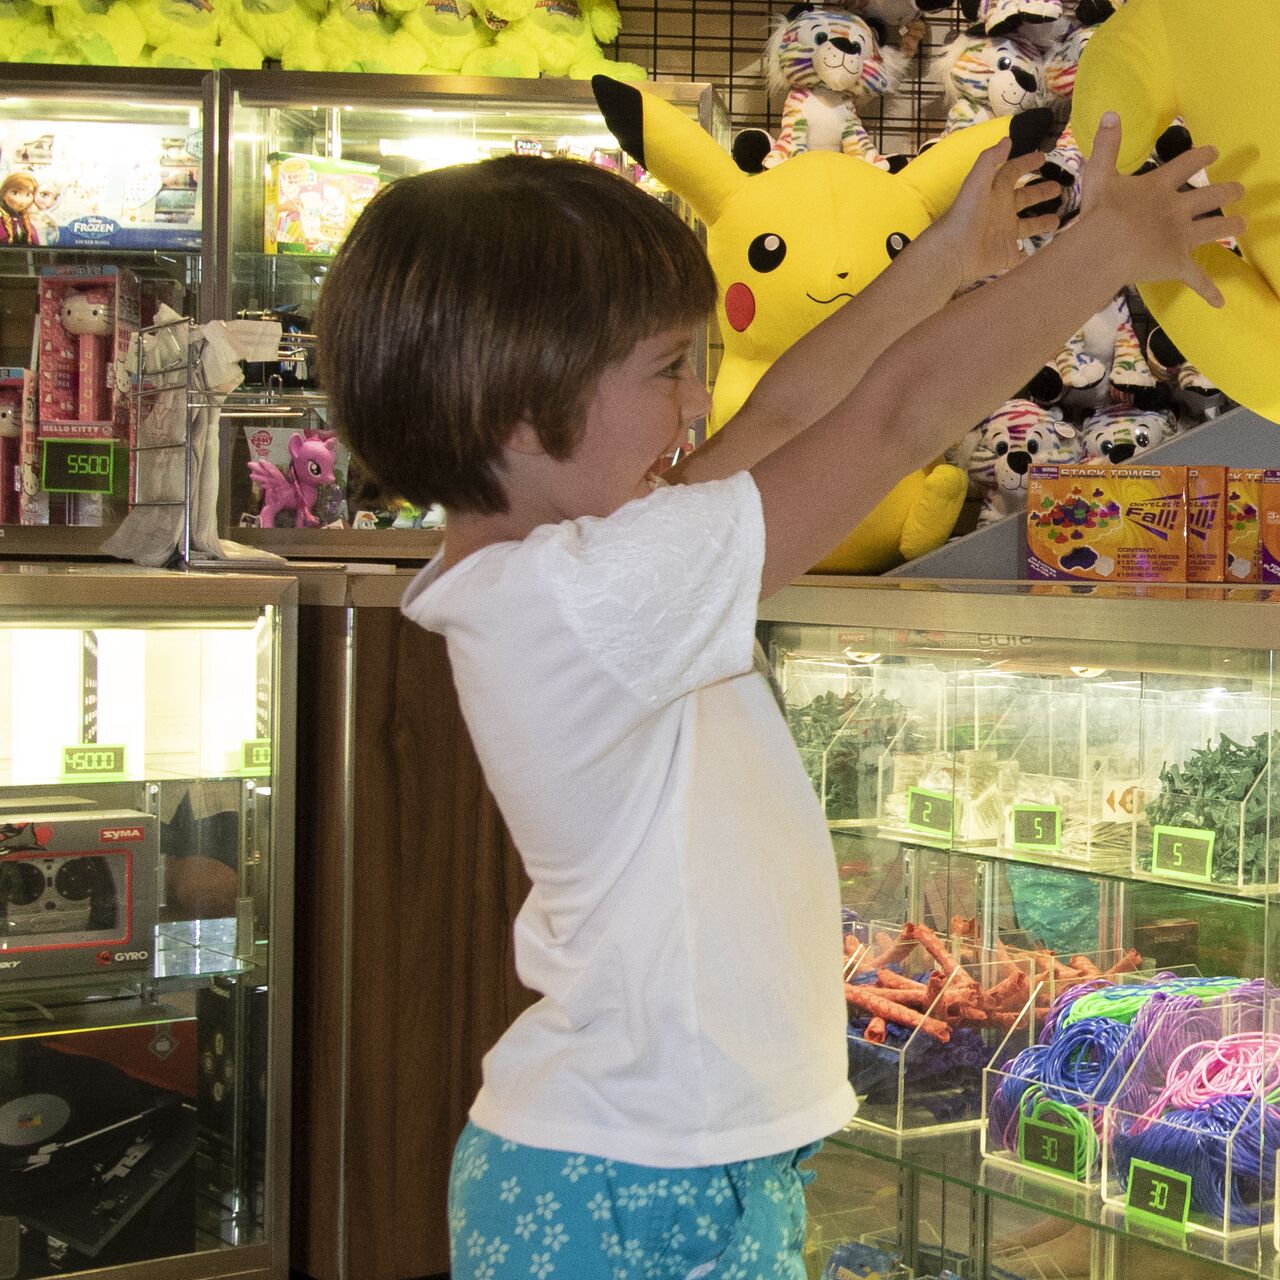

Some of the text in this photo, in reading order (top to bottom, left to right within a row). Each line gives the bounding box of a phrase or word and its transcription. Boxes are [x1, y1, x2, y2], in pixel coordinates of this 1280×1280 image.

[73, 223, 114, 234] FROZEN
[43, 424, 99, 434] HELLO KITTY
[67, 455, 110, 475] 5500
[1060, 469, 1107, 479] STACK
[1110, 469, 1162, 480] TOWER
[1125, 506, 1178, 530] Fall!
[65, 751, 115, 770] 45000
[921, 801, 933, 822] 2
[1033, 817, 1044, 839] 5
[1172, 842, 1183, 866] 5
[114, 950, 149, 963] GYRO
[1041, 1136, 1059, 1162] 30
[1149, 1180, 1170, 1210] 30
